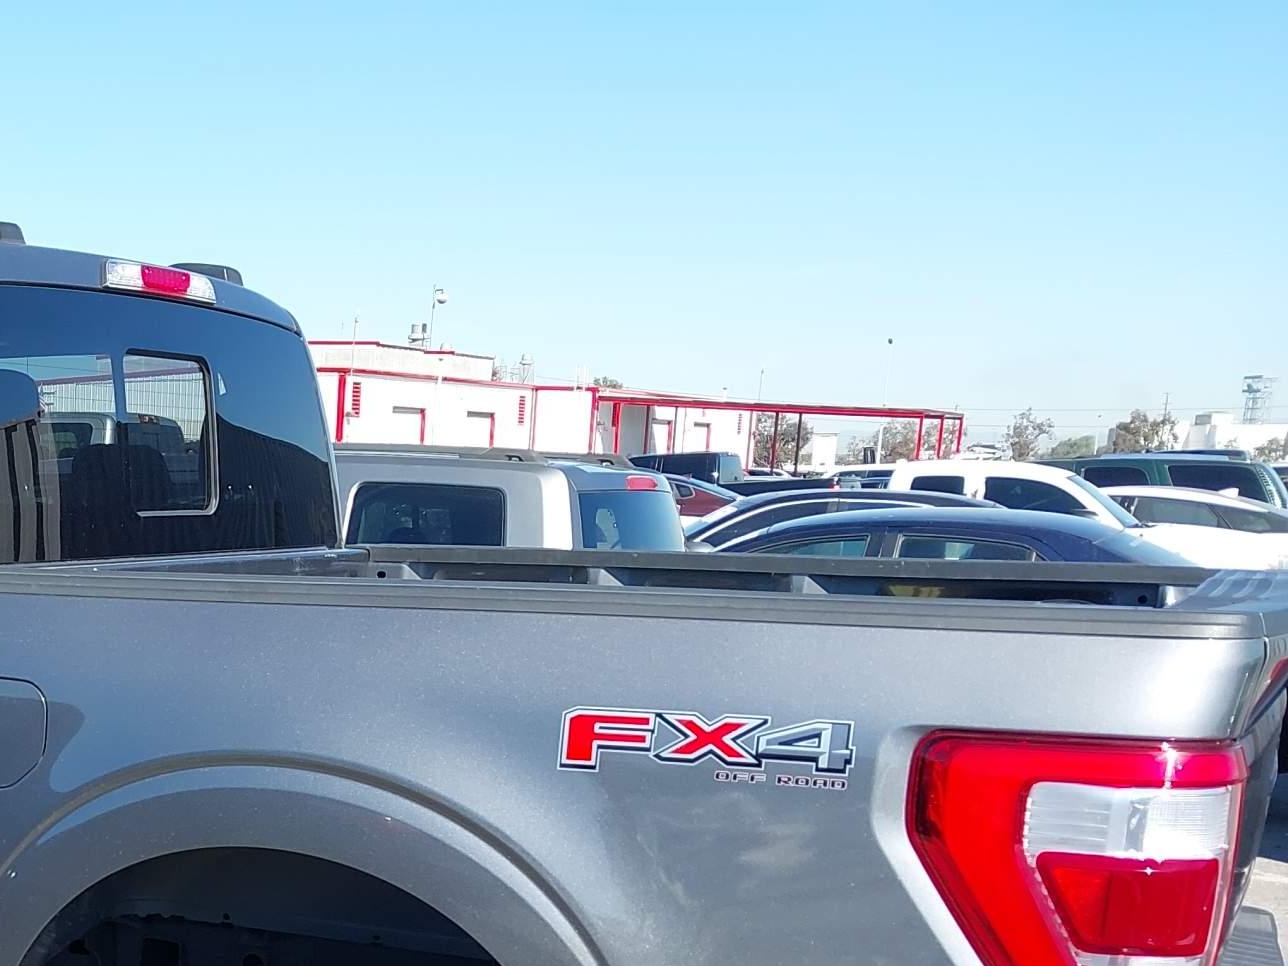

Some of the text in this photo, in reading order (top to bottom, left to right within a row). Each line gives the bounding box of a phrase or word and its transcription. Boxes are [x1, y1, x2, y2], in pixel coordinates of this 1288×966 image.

[558, 706, 856, 775] FX4
[714, 770, 849, 790] OFF ROAD
